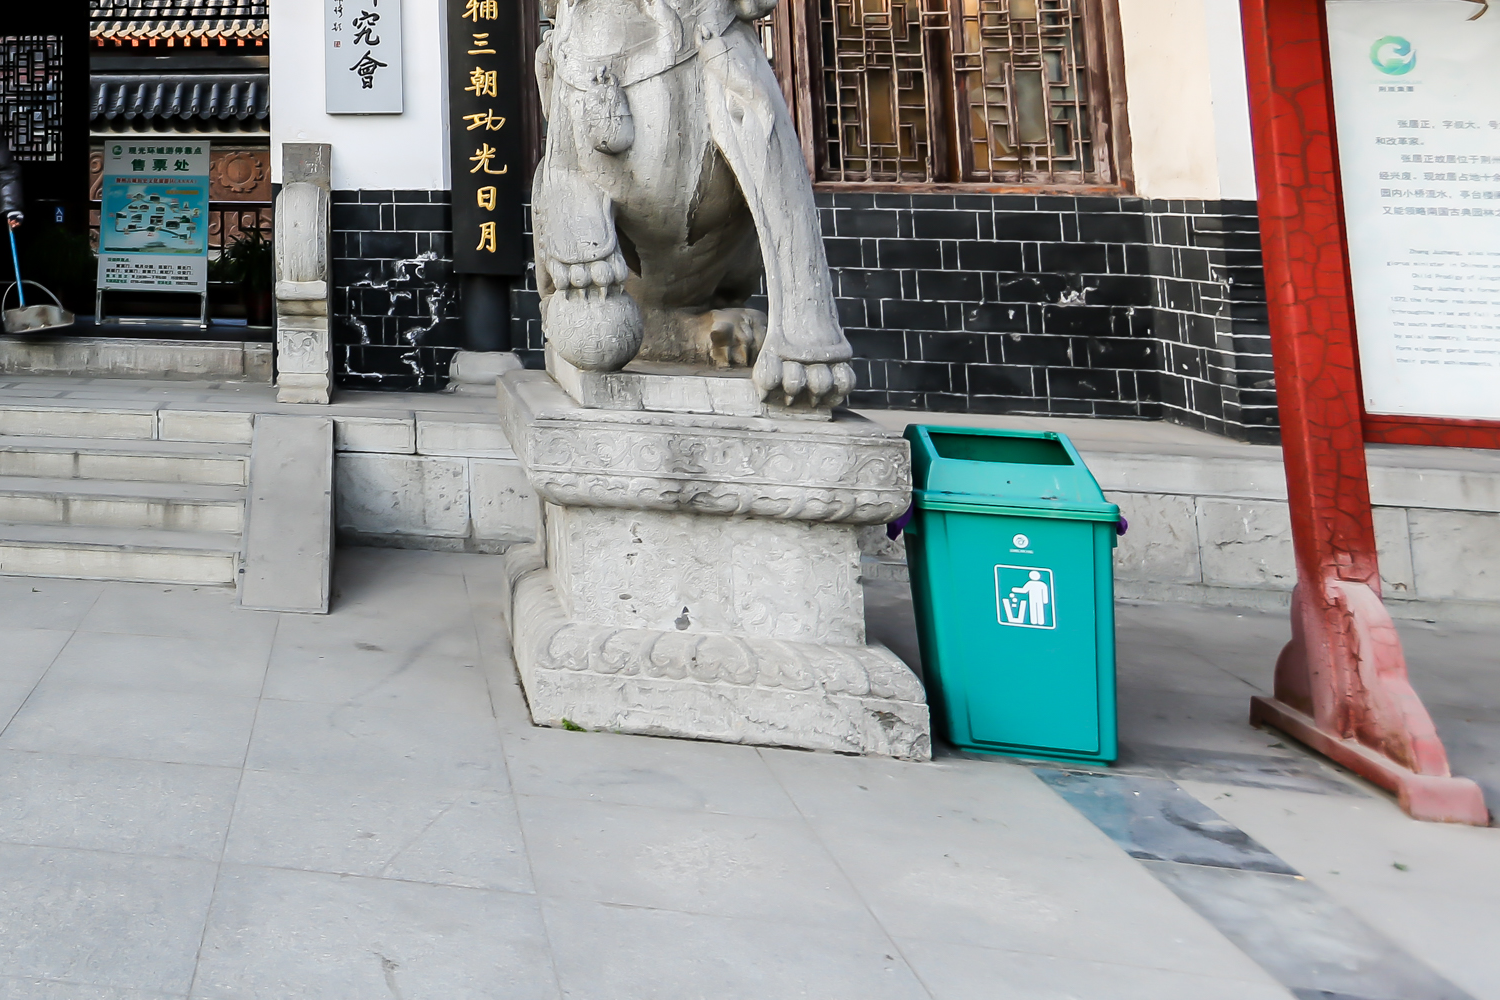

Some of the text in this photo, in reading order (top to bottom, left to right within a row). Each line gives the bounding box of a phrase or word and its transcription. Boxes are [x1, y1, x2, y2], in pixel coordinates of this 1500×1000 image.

[131, 158, 190, 172] 售票处
[55, 207, 63, 222] 入口
